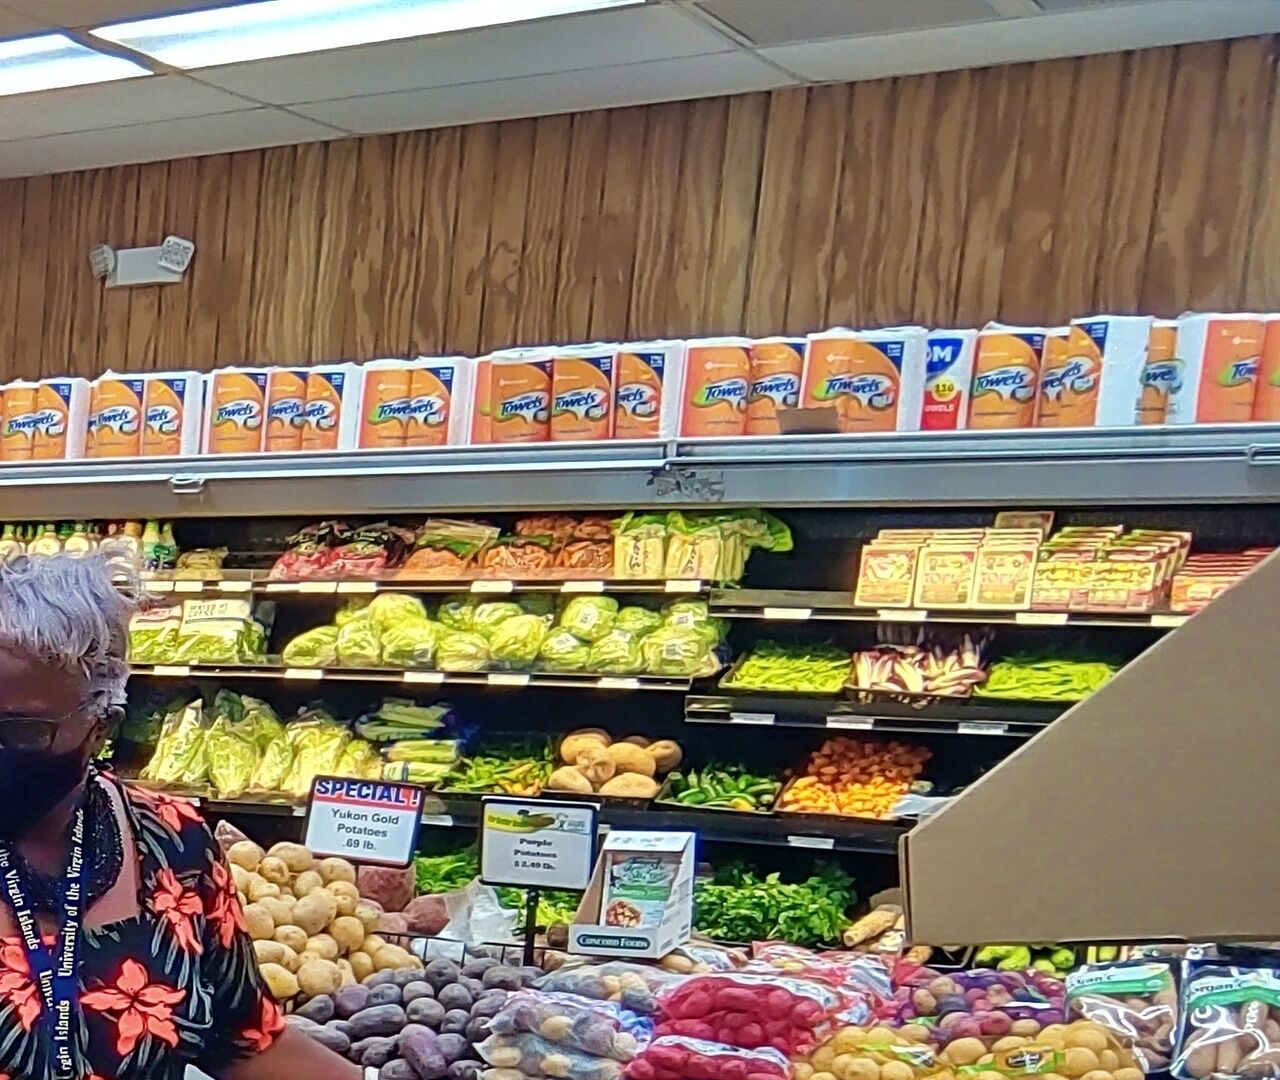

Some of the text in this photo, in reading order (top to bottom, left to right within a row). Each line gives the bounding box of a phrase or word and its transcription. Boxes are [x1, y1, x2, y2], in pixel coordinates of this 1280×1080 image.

[825, 376, 852, 395] Tow
[976, 370, 1026, 392] Towels
[147, 408, 170, 421] wels
[217, 404, 254, 421] Towels
[331, 808, 400, 825] Yukon Gold
[337, 823, 388, 838] Potatoes
[519, 837, 553, 847] Purple
[66, 846, 82, 879] Virgin
[513, 849, 558, 859] Potatoes
[66, 882, 80, 901] the
[4, 869, 25, 908] Virgin
[17, 908, 39, 950] Islands
[64, 904, 78, 916] of
[58, 918, 79, 977] University
[54, 999, 72, 1072] rgin Islands
